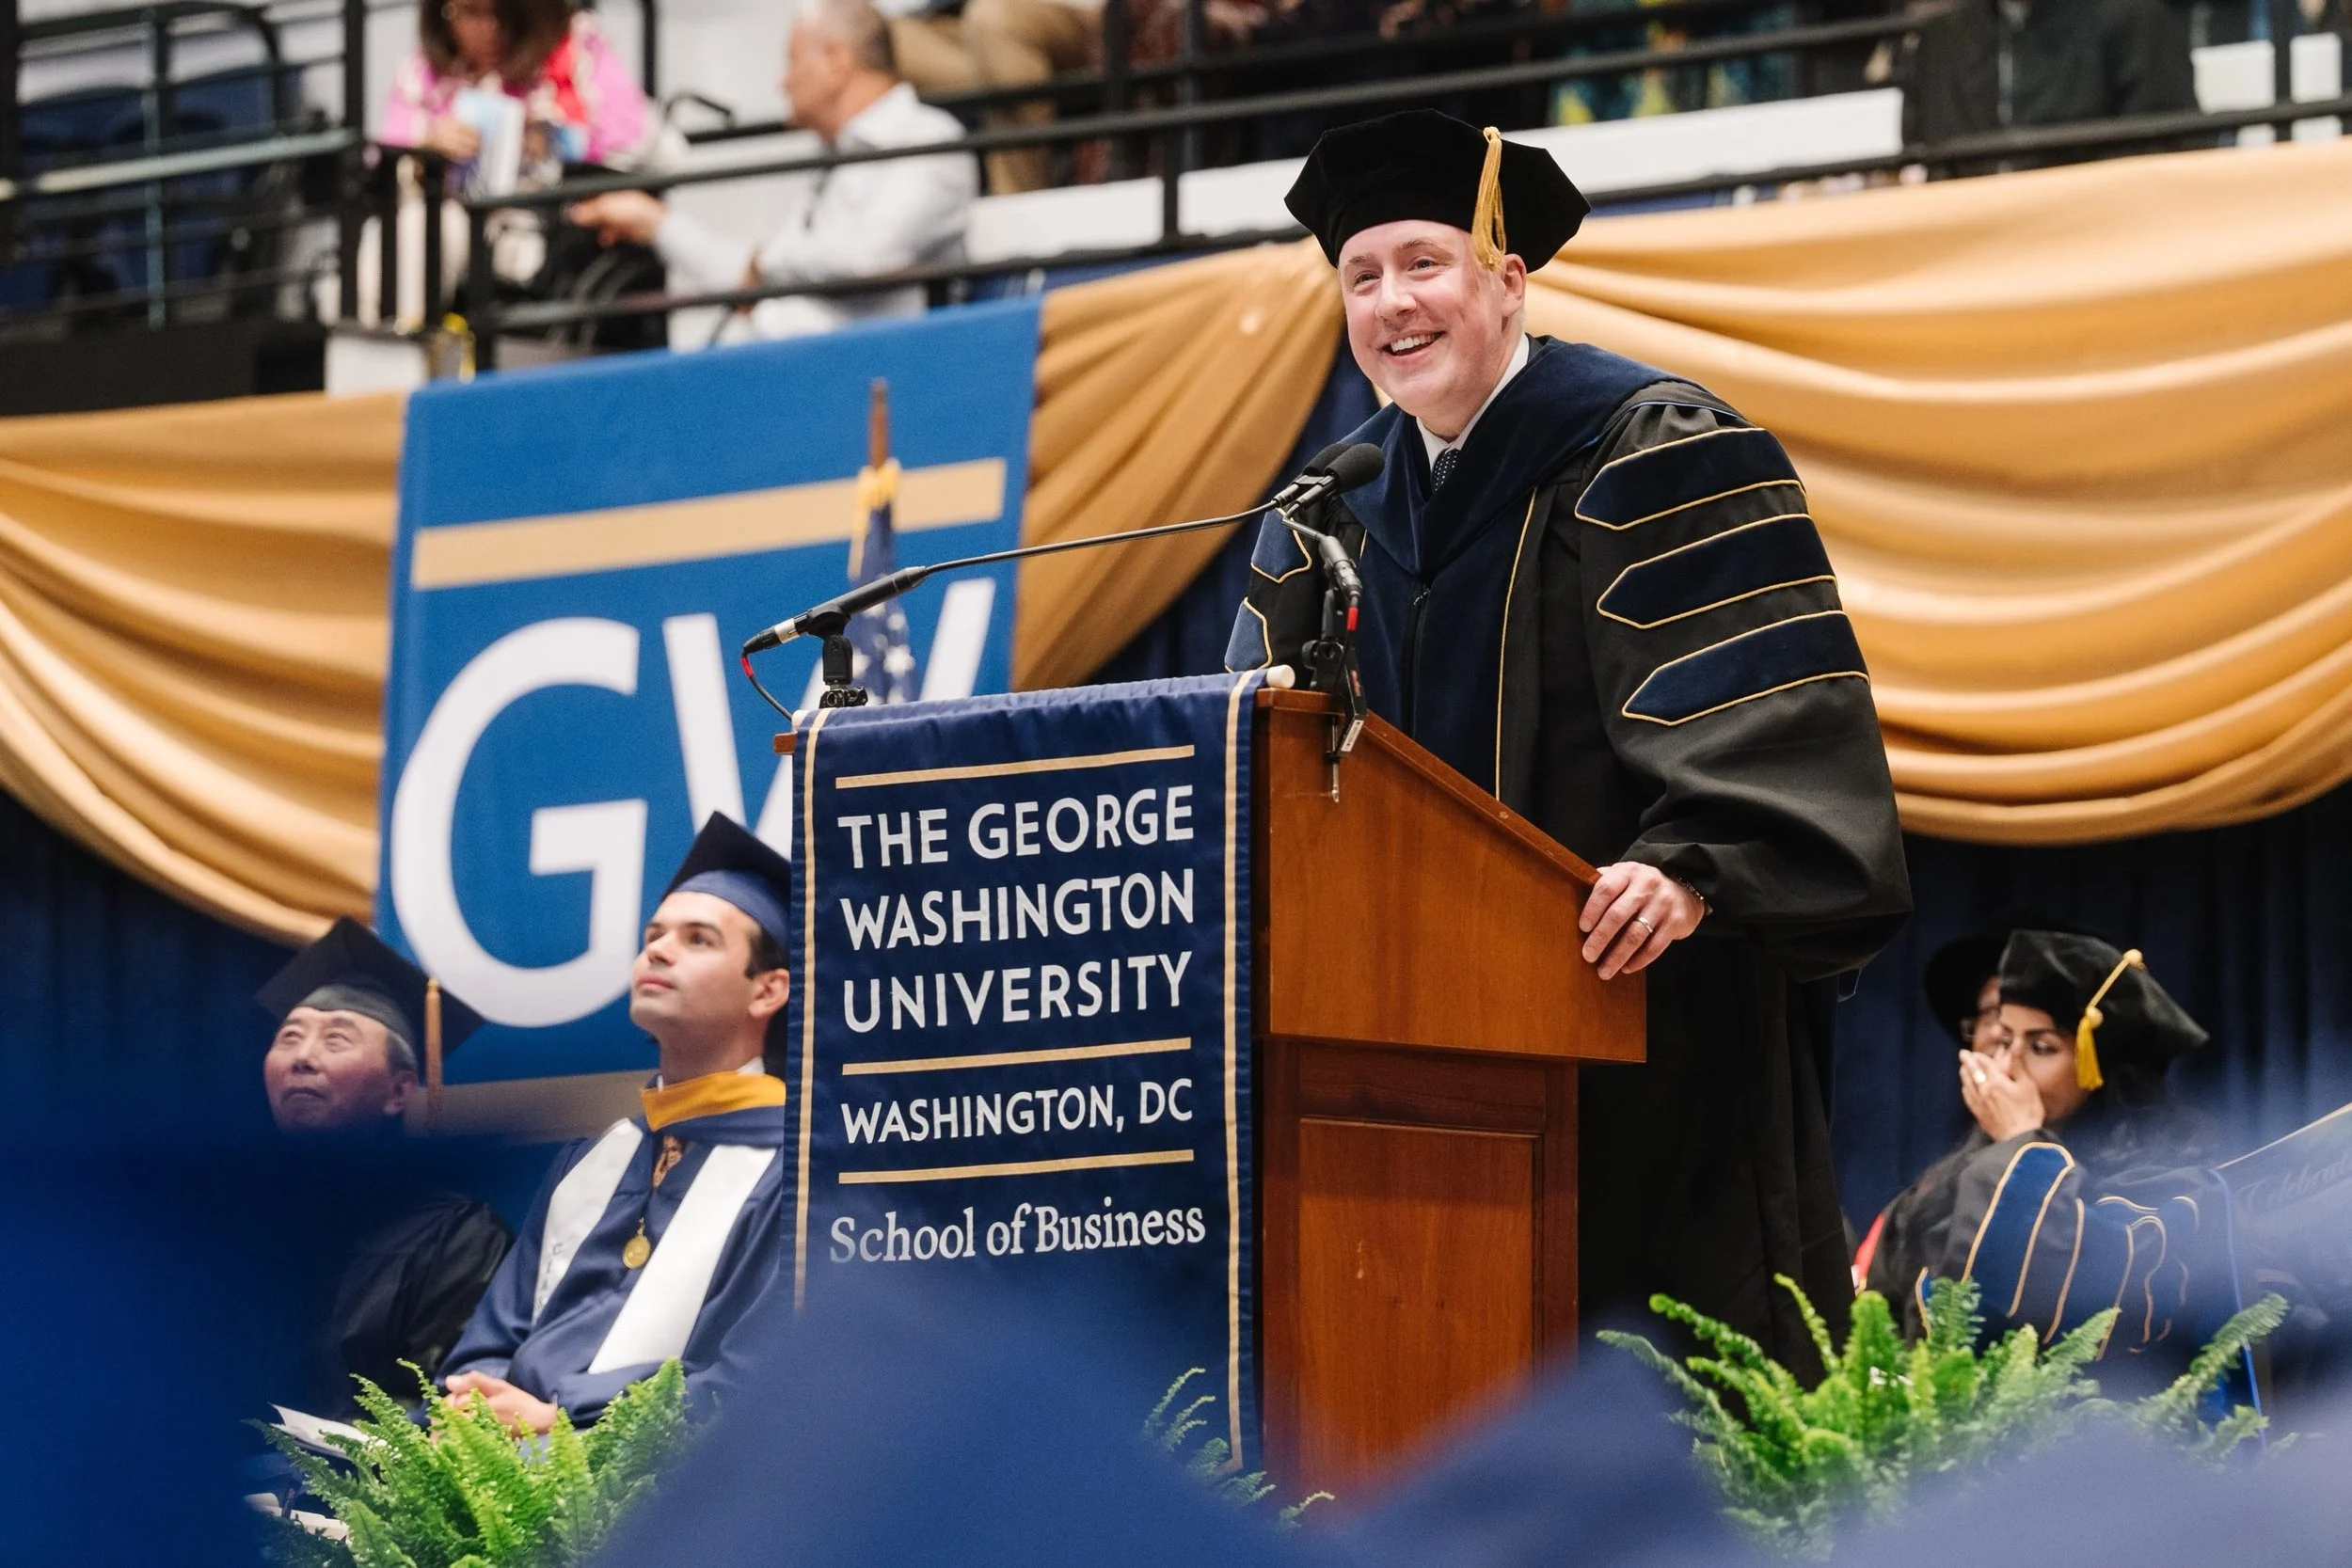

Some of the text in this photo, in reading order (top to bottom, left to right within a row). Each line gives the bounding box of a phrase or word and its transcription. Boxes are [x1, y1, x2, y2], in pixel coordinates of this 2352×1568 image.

[838, 784, 1194, 869] THE GEORGE
[839, 868, 1194, 951] WASHINGTON
[844, 951, 1193, 1033] UNIVERSITY
[841, 1078, 1193, 1145] WASHINGTON, DC
[830, 1196, 1206, 1263] School of Business
